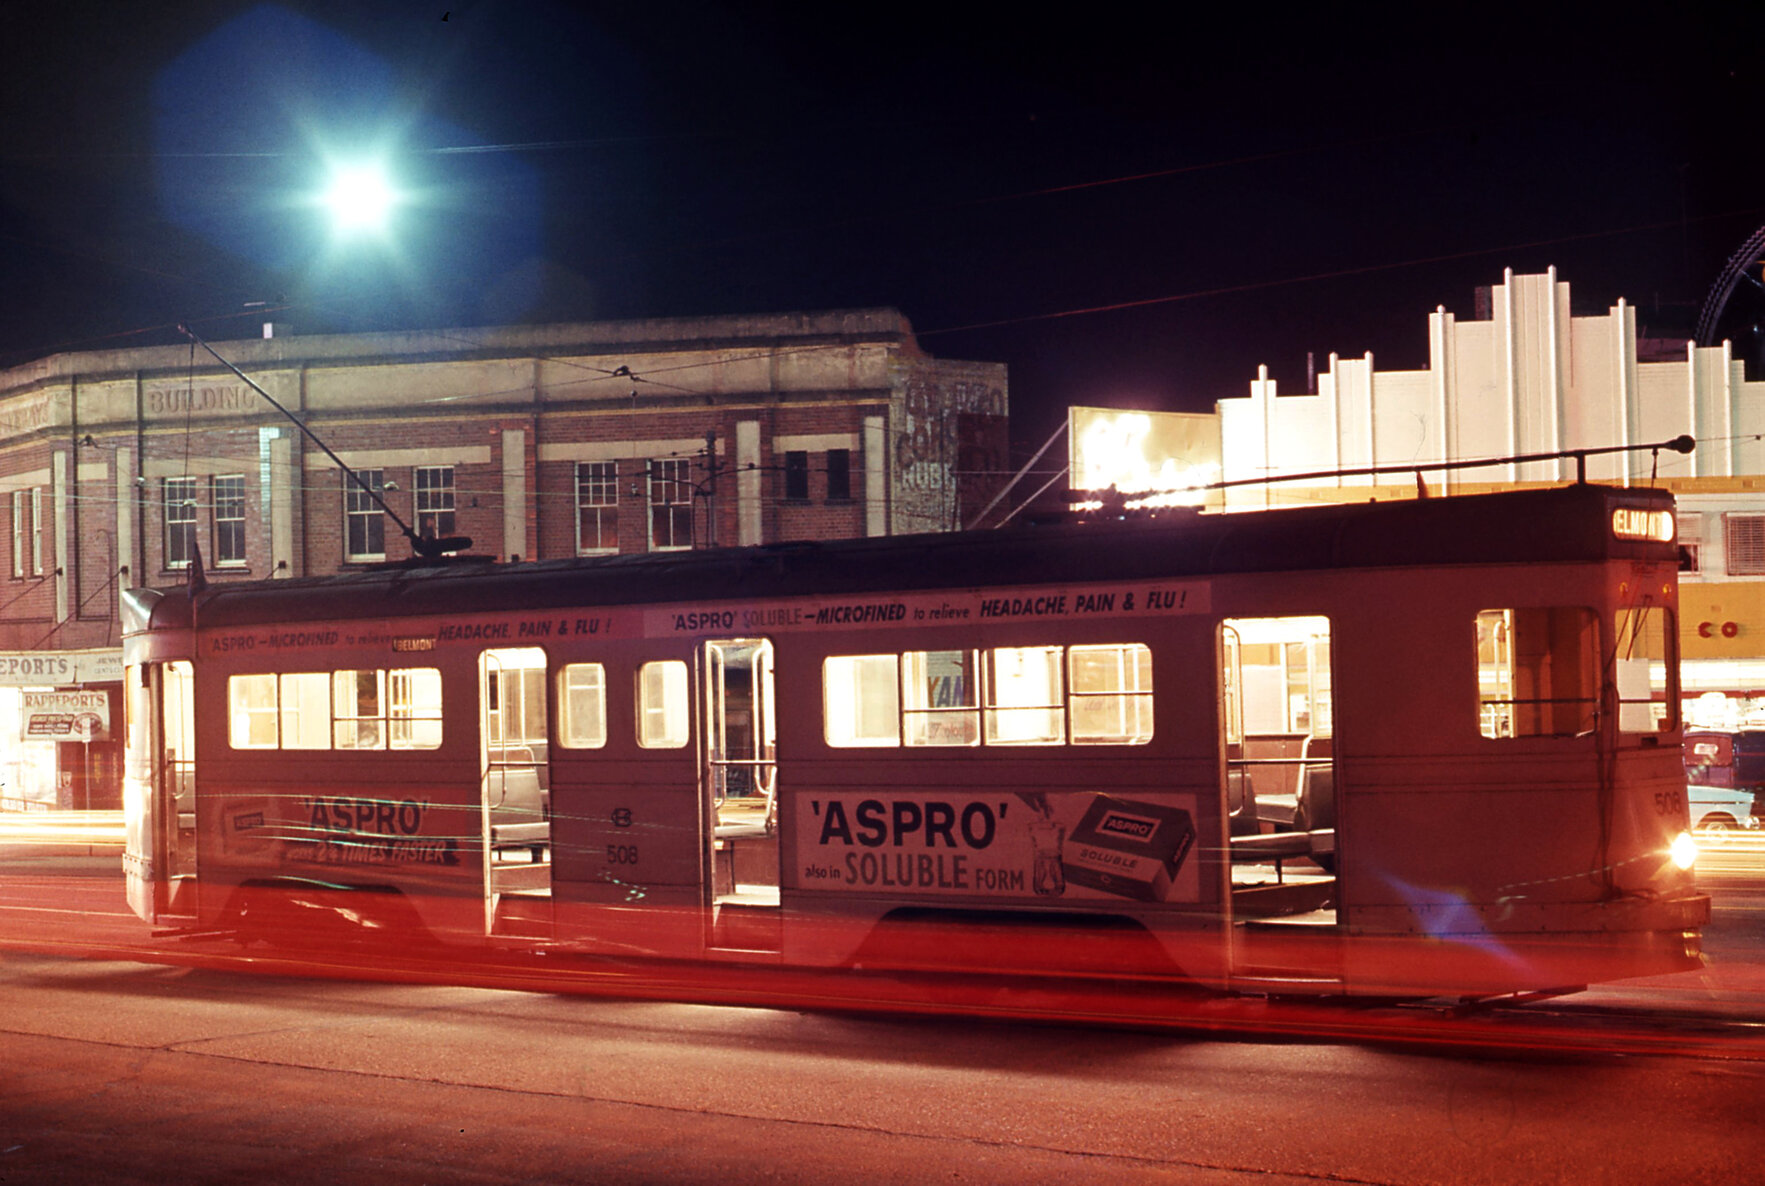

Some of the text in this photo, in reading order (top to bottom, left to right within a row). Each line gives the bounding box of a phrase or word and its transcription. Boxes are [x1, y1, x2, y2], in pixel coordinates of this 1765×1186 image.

[149, 386, 257, 413] BUILDING
[743, 608, 803, 629] SOLUBLE
[914, 608, 924, 620] to
[929, 604, 970, 619] relieve
[1074, 593, 1115, 613] PAIN
[1122, 592, 1134, 610] &
[519, 621, 552, 637] PAIN
[558, 620, 568, 635] &
[303, 796, 430, 835] 'ASPRO'
[1654, 791, 1681, 815] 508
[812, 800, 1009, 849] 'ASPRO'
[391, 840, 447, 864] FASTER
[606, 845, 638, 865] 508
[1080, 848, 1138, 868] SOLUBLE
[805, 852, 1024, 891] also in SOLUBLE FORM
